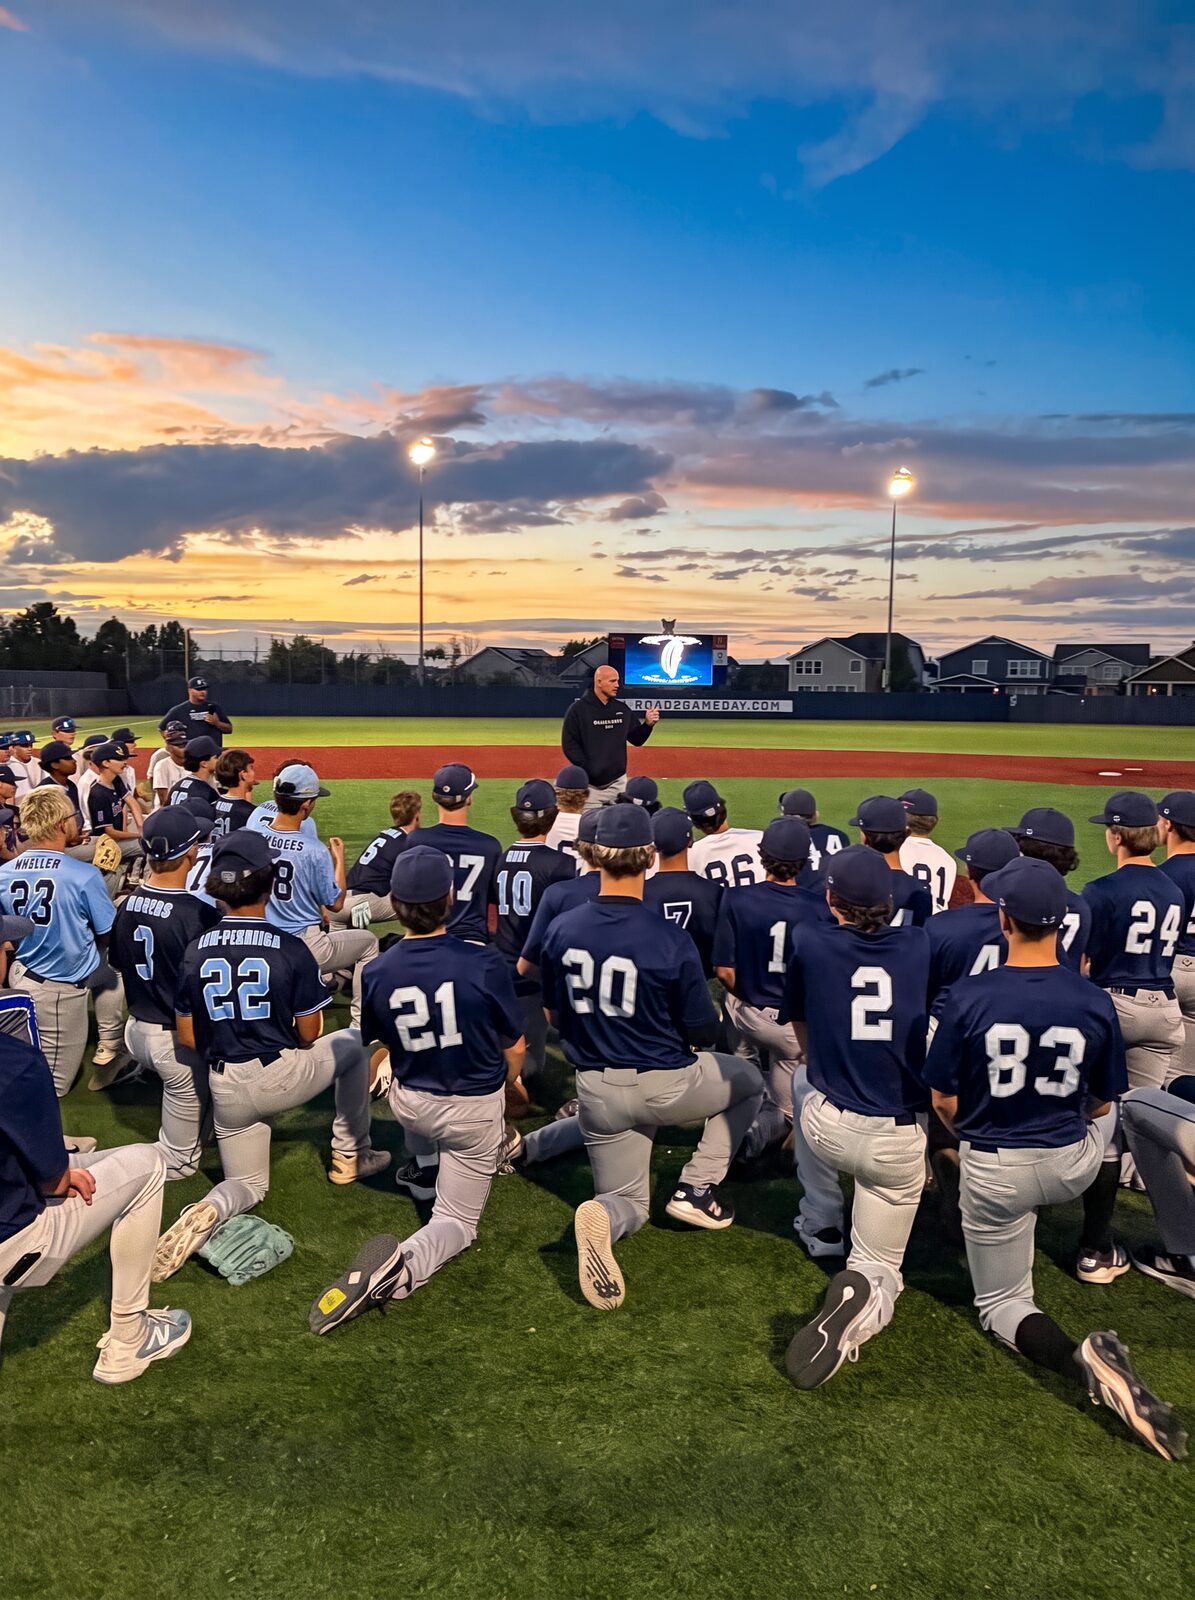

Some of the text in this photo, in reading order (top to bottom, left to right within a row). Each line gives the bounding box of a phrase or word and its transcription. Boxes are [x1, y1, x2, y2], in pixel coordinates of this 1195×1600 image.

[634, 699, 781, 712] ROAD2GAMEDAY.COM
[358, 837, 387, 866] 6
[445, 853, 485, 902] 7
[9, 877, 56, 927] 23
[272, 859, 295, 902] 8
[496, 870, 533, 917] 10
[133, 924, 154, 981] 3
[767, 920, 787, 974] 1
[1124, 899, 1181, 957] 24
[200, 957, 271, 1022] 22
[561, 947, 638, 1018] 20
[850, 965, 893, 1041] 2
[389, 981, 464, 1052] 21
[984, 1022, 1087, 1098] 83
